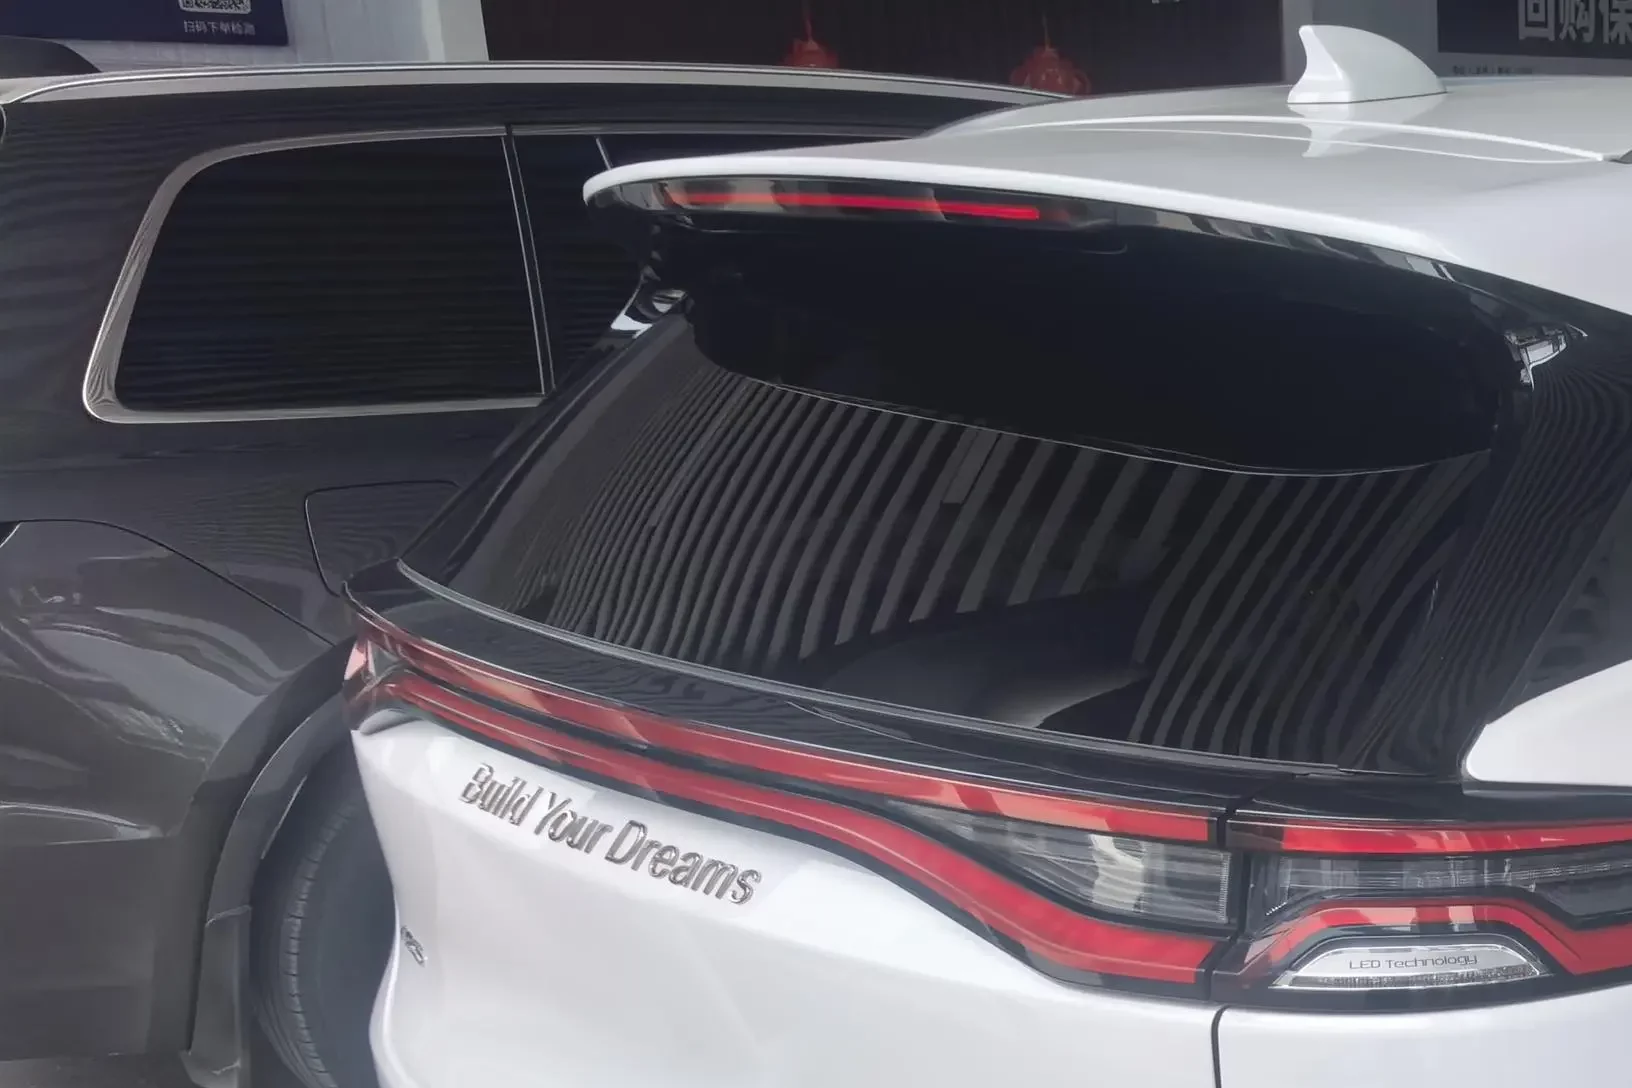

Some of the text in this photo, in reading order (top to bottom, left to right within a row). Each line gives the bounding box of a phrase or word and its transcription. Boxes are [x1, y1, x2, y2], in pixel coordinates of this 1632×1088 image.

[459, 762, 762, 905] Build Your Dreams
[1349, 953, 1478, 970] LED Technology
